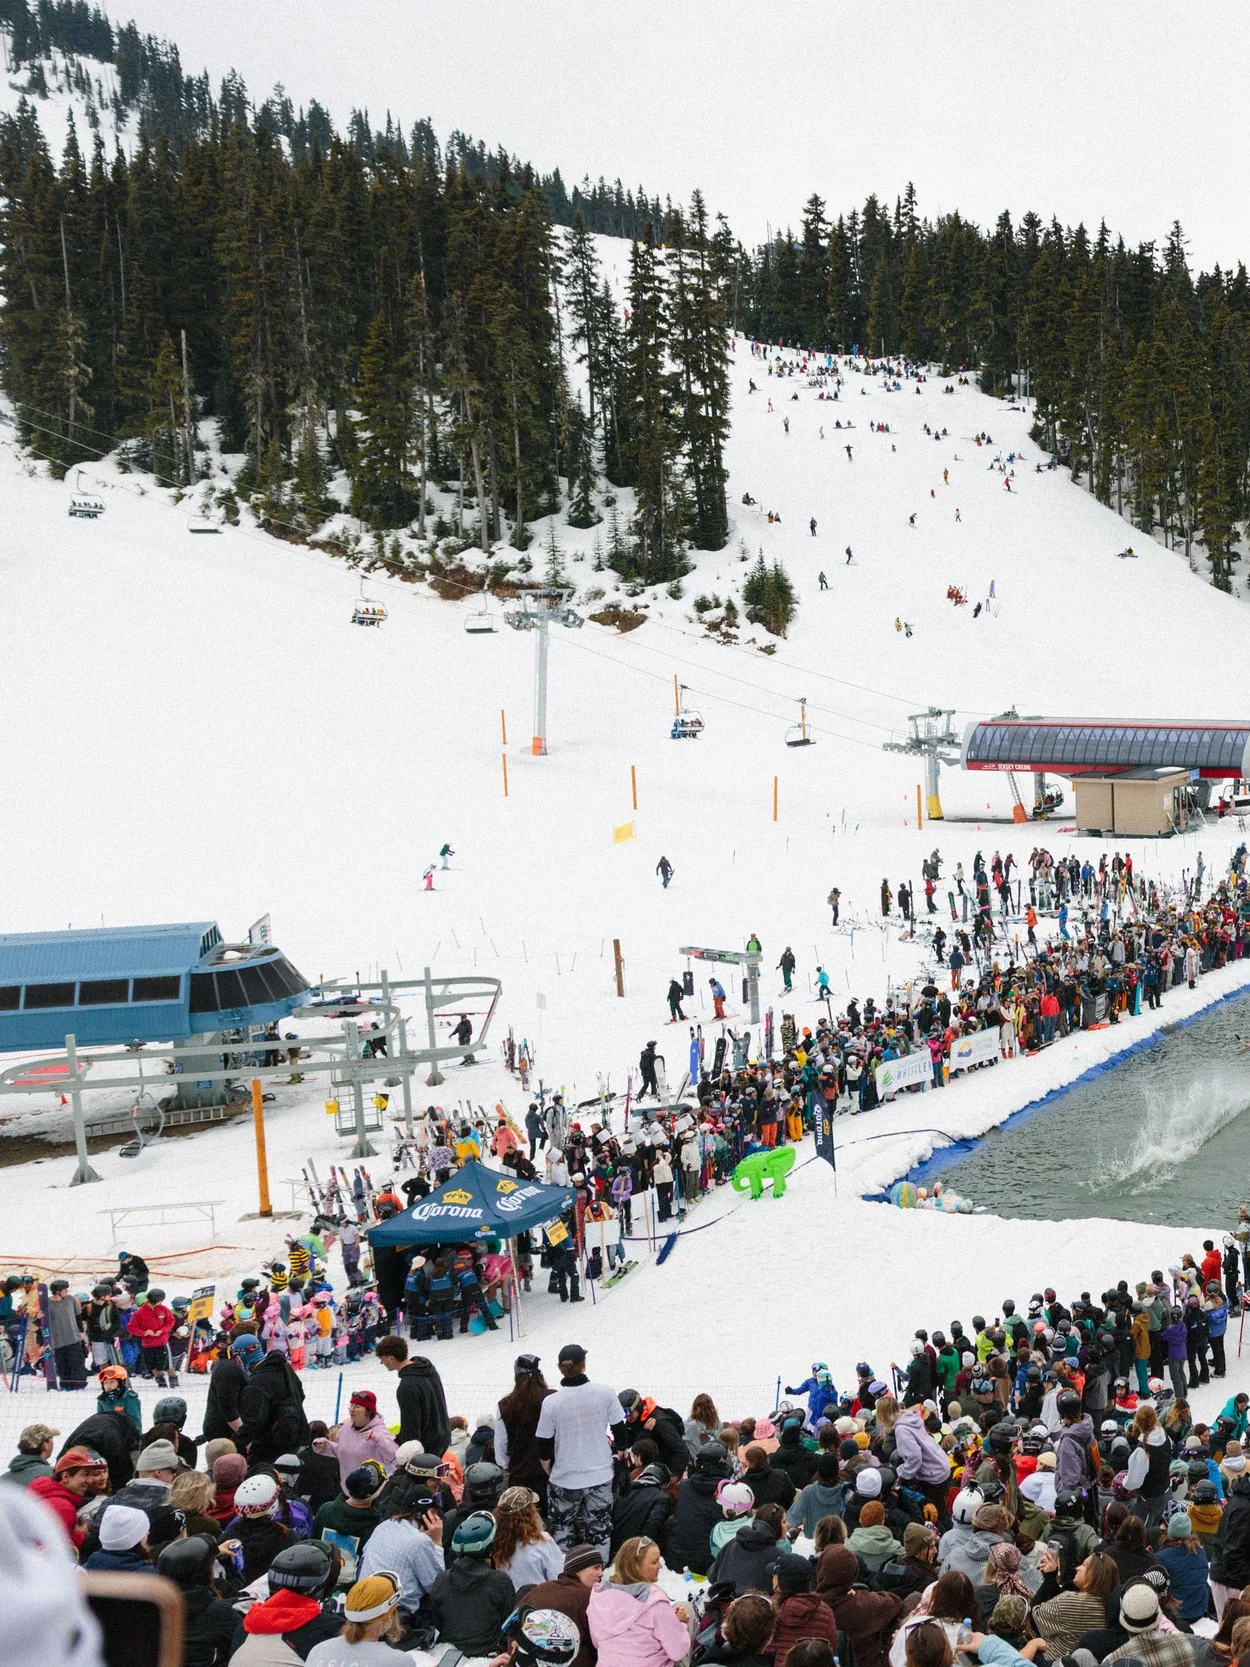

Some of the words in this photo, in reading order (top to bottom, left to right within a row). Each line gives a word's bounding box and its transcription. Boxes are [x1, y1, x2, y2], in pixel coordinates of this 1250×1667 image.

[813, 1103, 824, 1145] Corona
[411, 1202, 484, 1221] Corona
[496, 1185, 545, 1212] Corona
